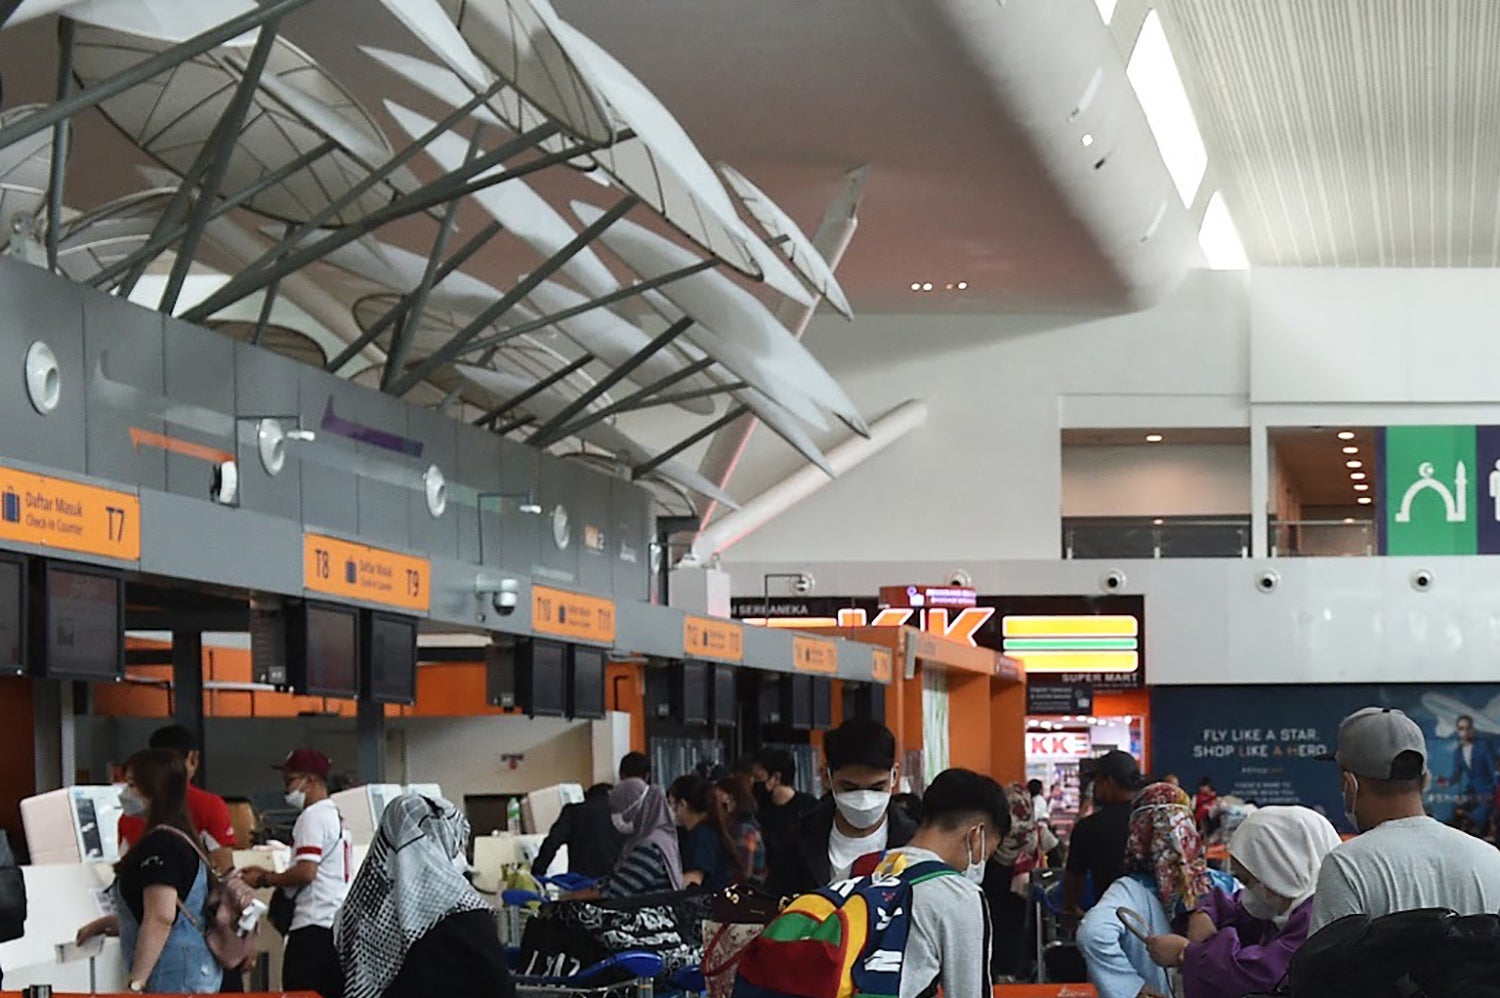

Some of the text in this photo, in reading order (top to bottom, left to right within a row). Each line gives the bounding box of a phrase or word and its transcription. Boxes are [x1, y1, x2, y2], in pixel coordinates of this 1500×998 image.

[25, 491, 82, 517] Daftar Masuk
[106, 506, 124, 541] T7
[315, 548, 329, 580] T8
[406, 568, 420, 598] T9
[1062, 672, 1138, 682] SUPER MART
[1203, 728, 1228, 742] FLY
[1231, 728, 1261, 742] LIKE
[1265, 729, 1276, 741] A
[1193, 745, 1235, 758] SHOP
[1238, 744, 1268, 757] LIKE
[1272, 745, 1283, 757] A
